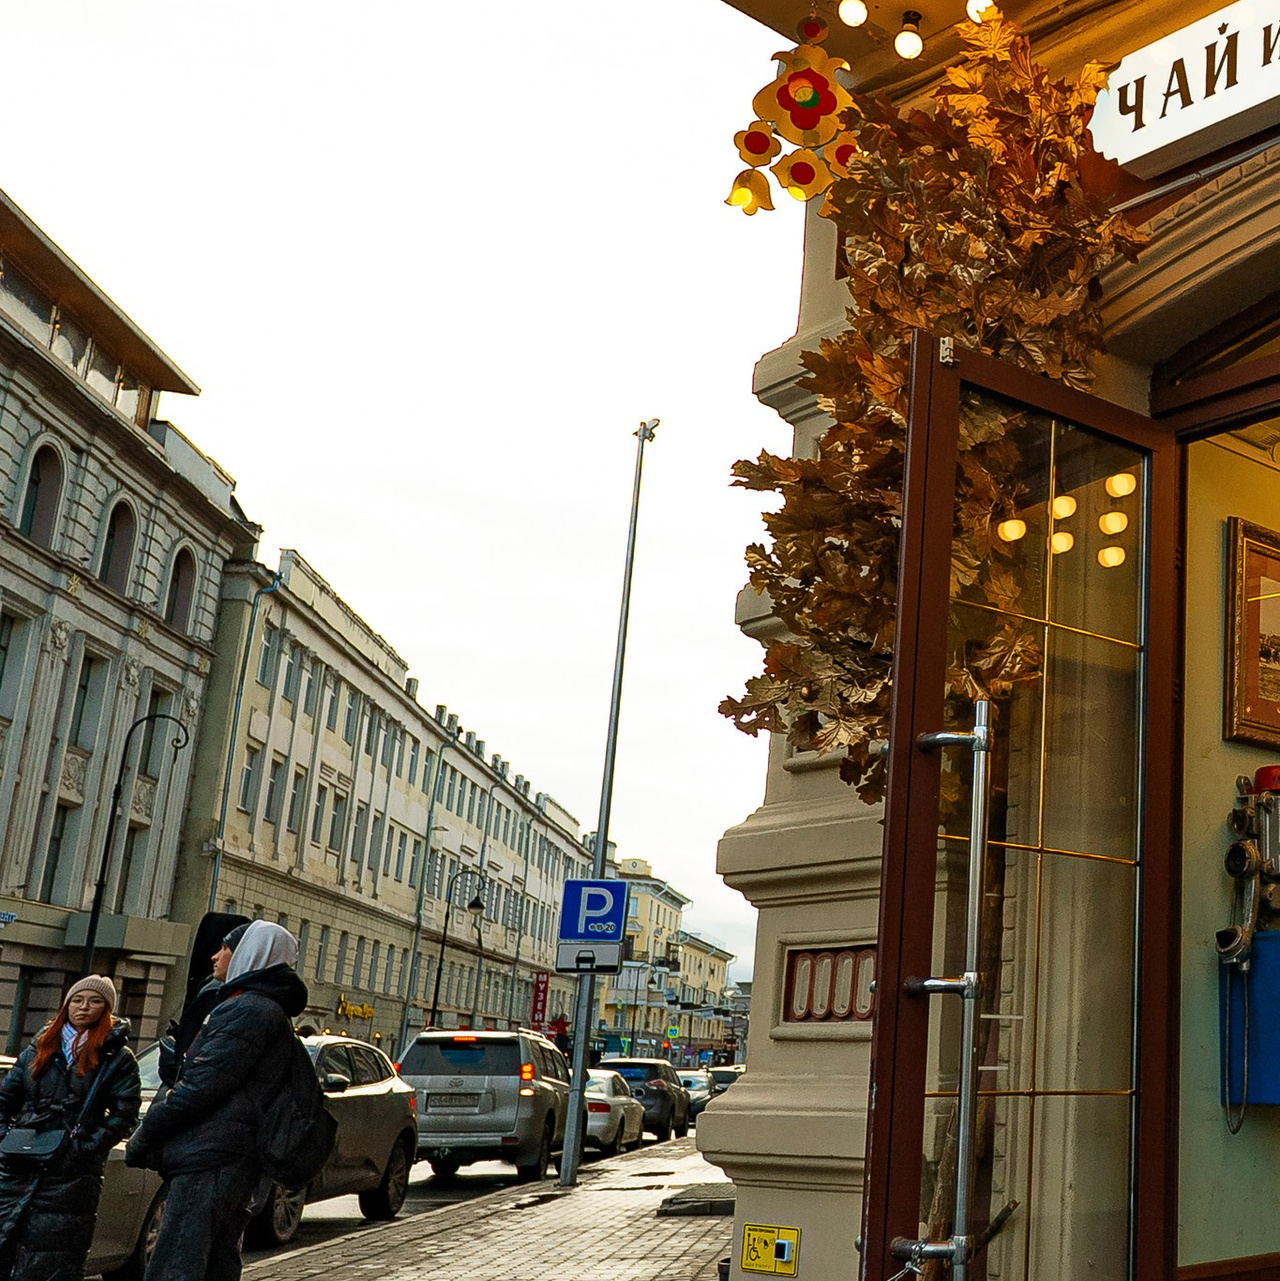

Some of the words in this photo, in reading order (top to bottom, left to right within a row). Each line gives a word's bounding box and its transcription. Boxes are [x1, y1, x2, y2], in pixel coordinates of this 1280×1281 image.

[1117, 22, 1240, 133] ЧАЙ
[577, 886, 614, 934] P
[534, 973, 548, 1021] МУЗЕЙ
